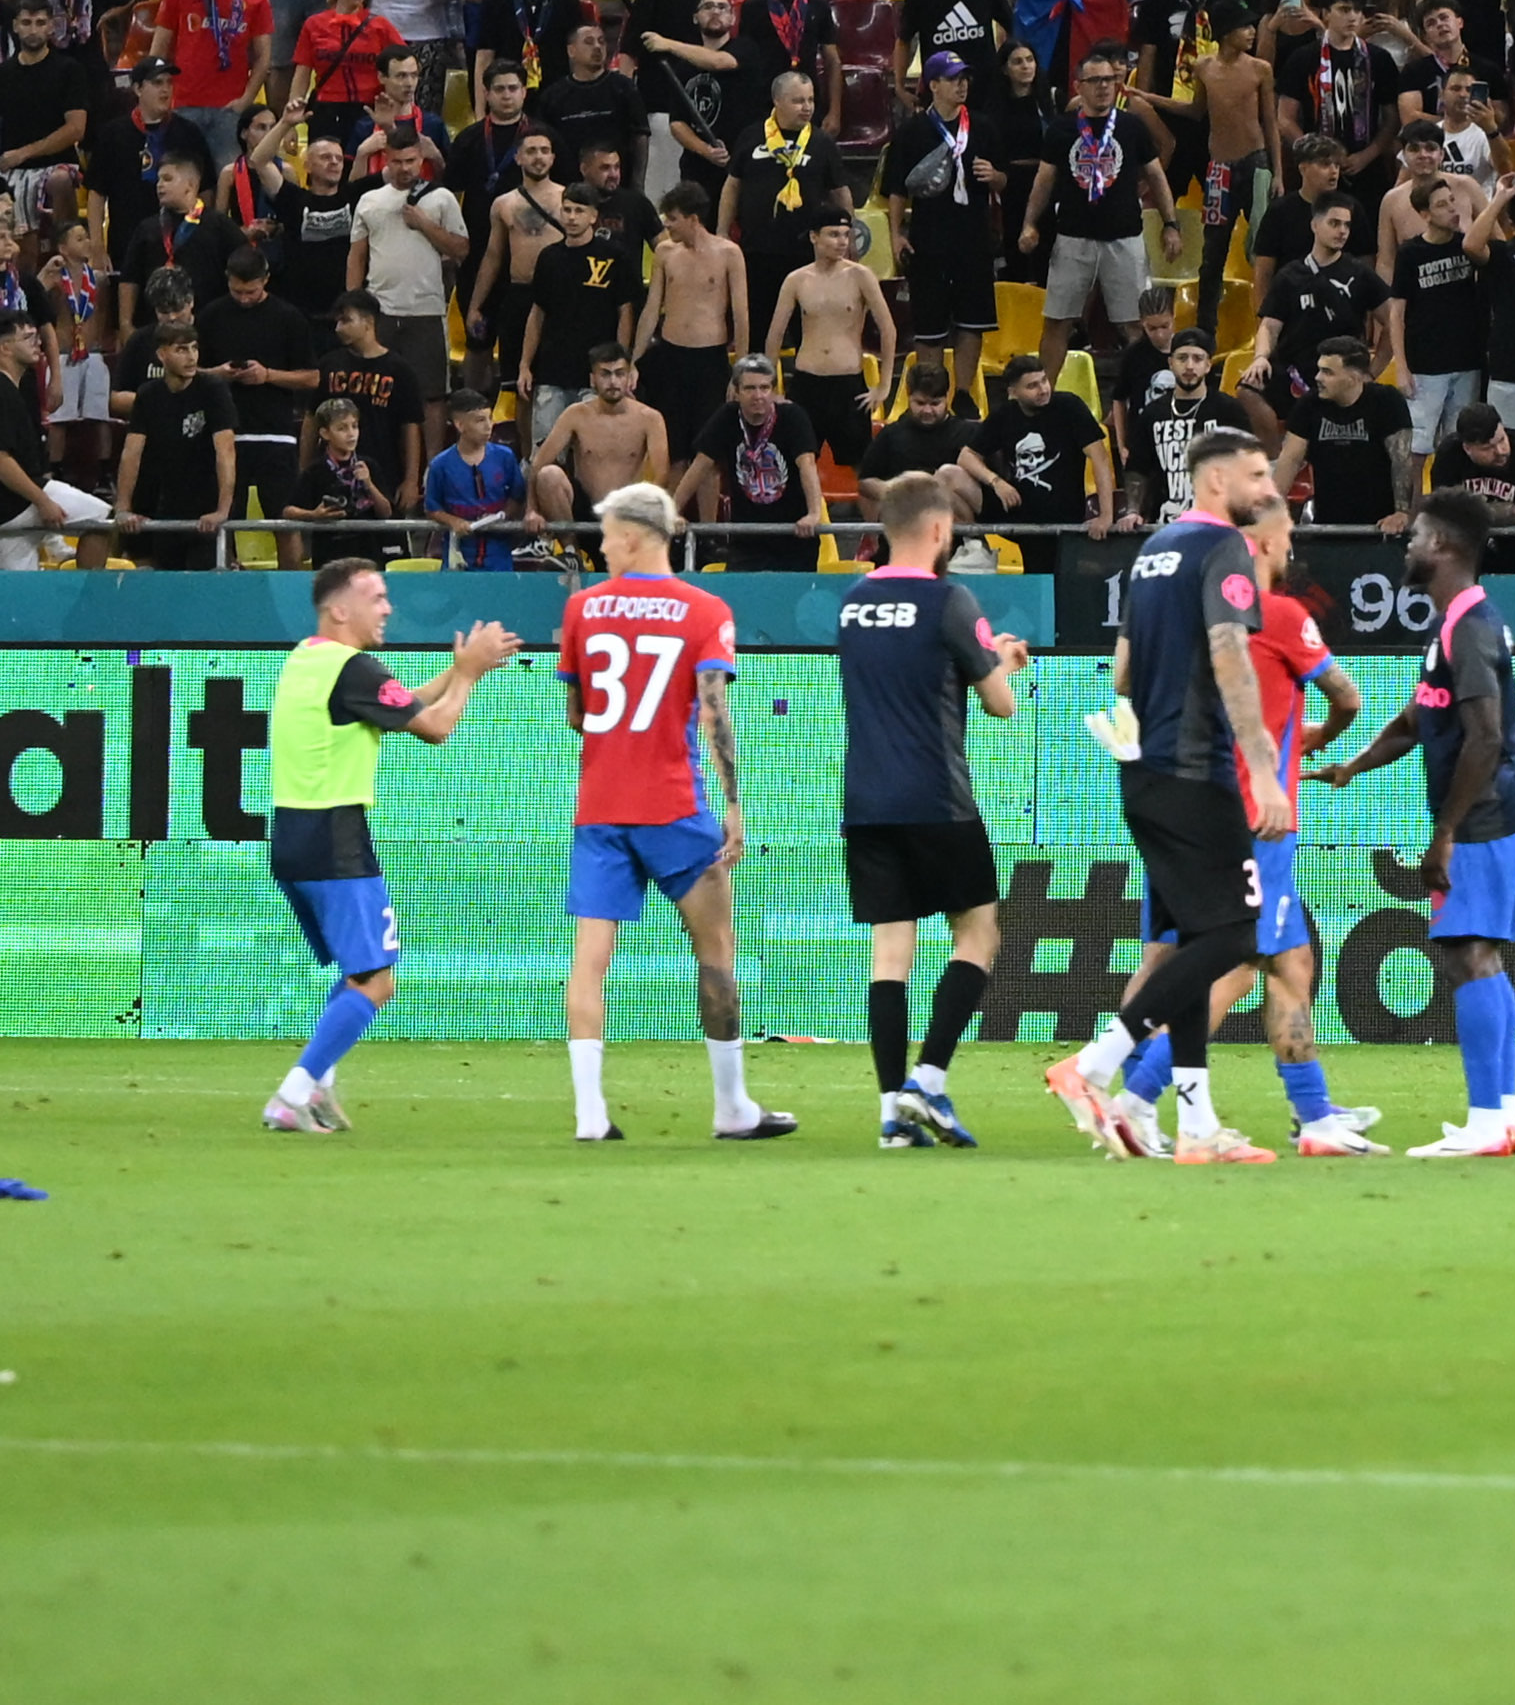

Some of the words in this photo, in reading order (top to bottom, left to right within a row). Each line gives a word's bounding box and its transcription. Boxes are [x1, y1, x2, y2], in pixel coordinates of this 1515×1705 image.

[932, 25, 986, 45] adidas
[1153, 419, 1195, 443] C'EST
[1130, 551, 1182, 582] FCSB
[840, 602, 918, 629] FCSB
[581, 632, 687, 735] 37
